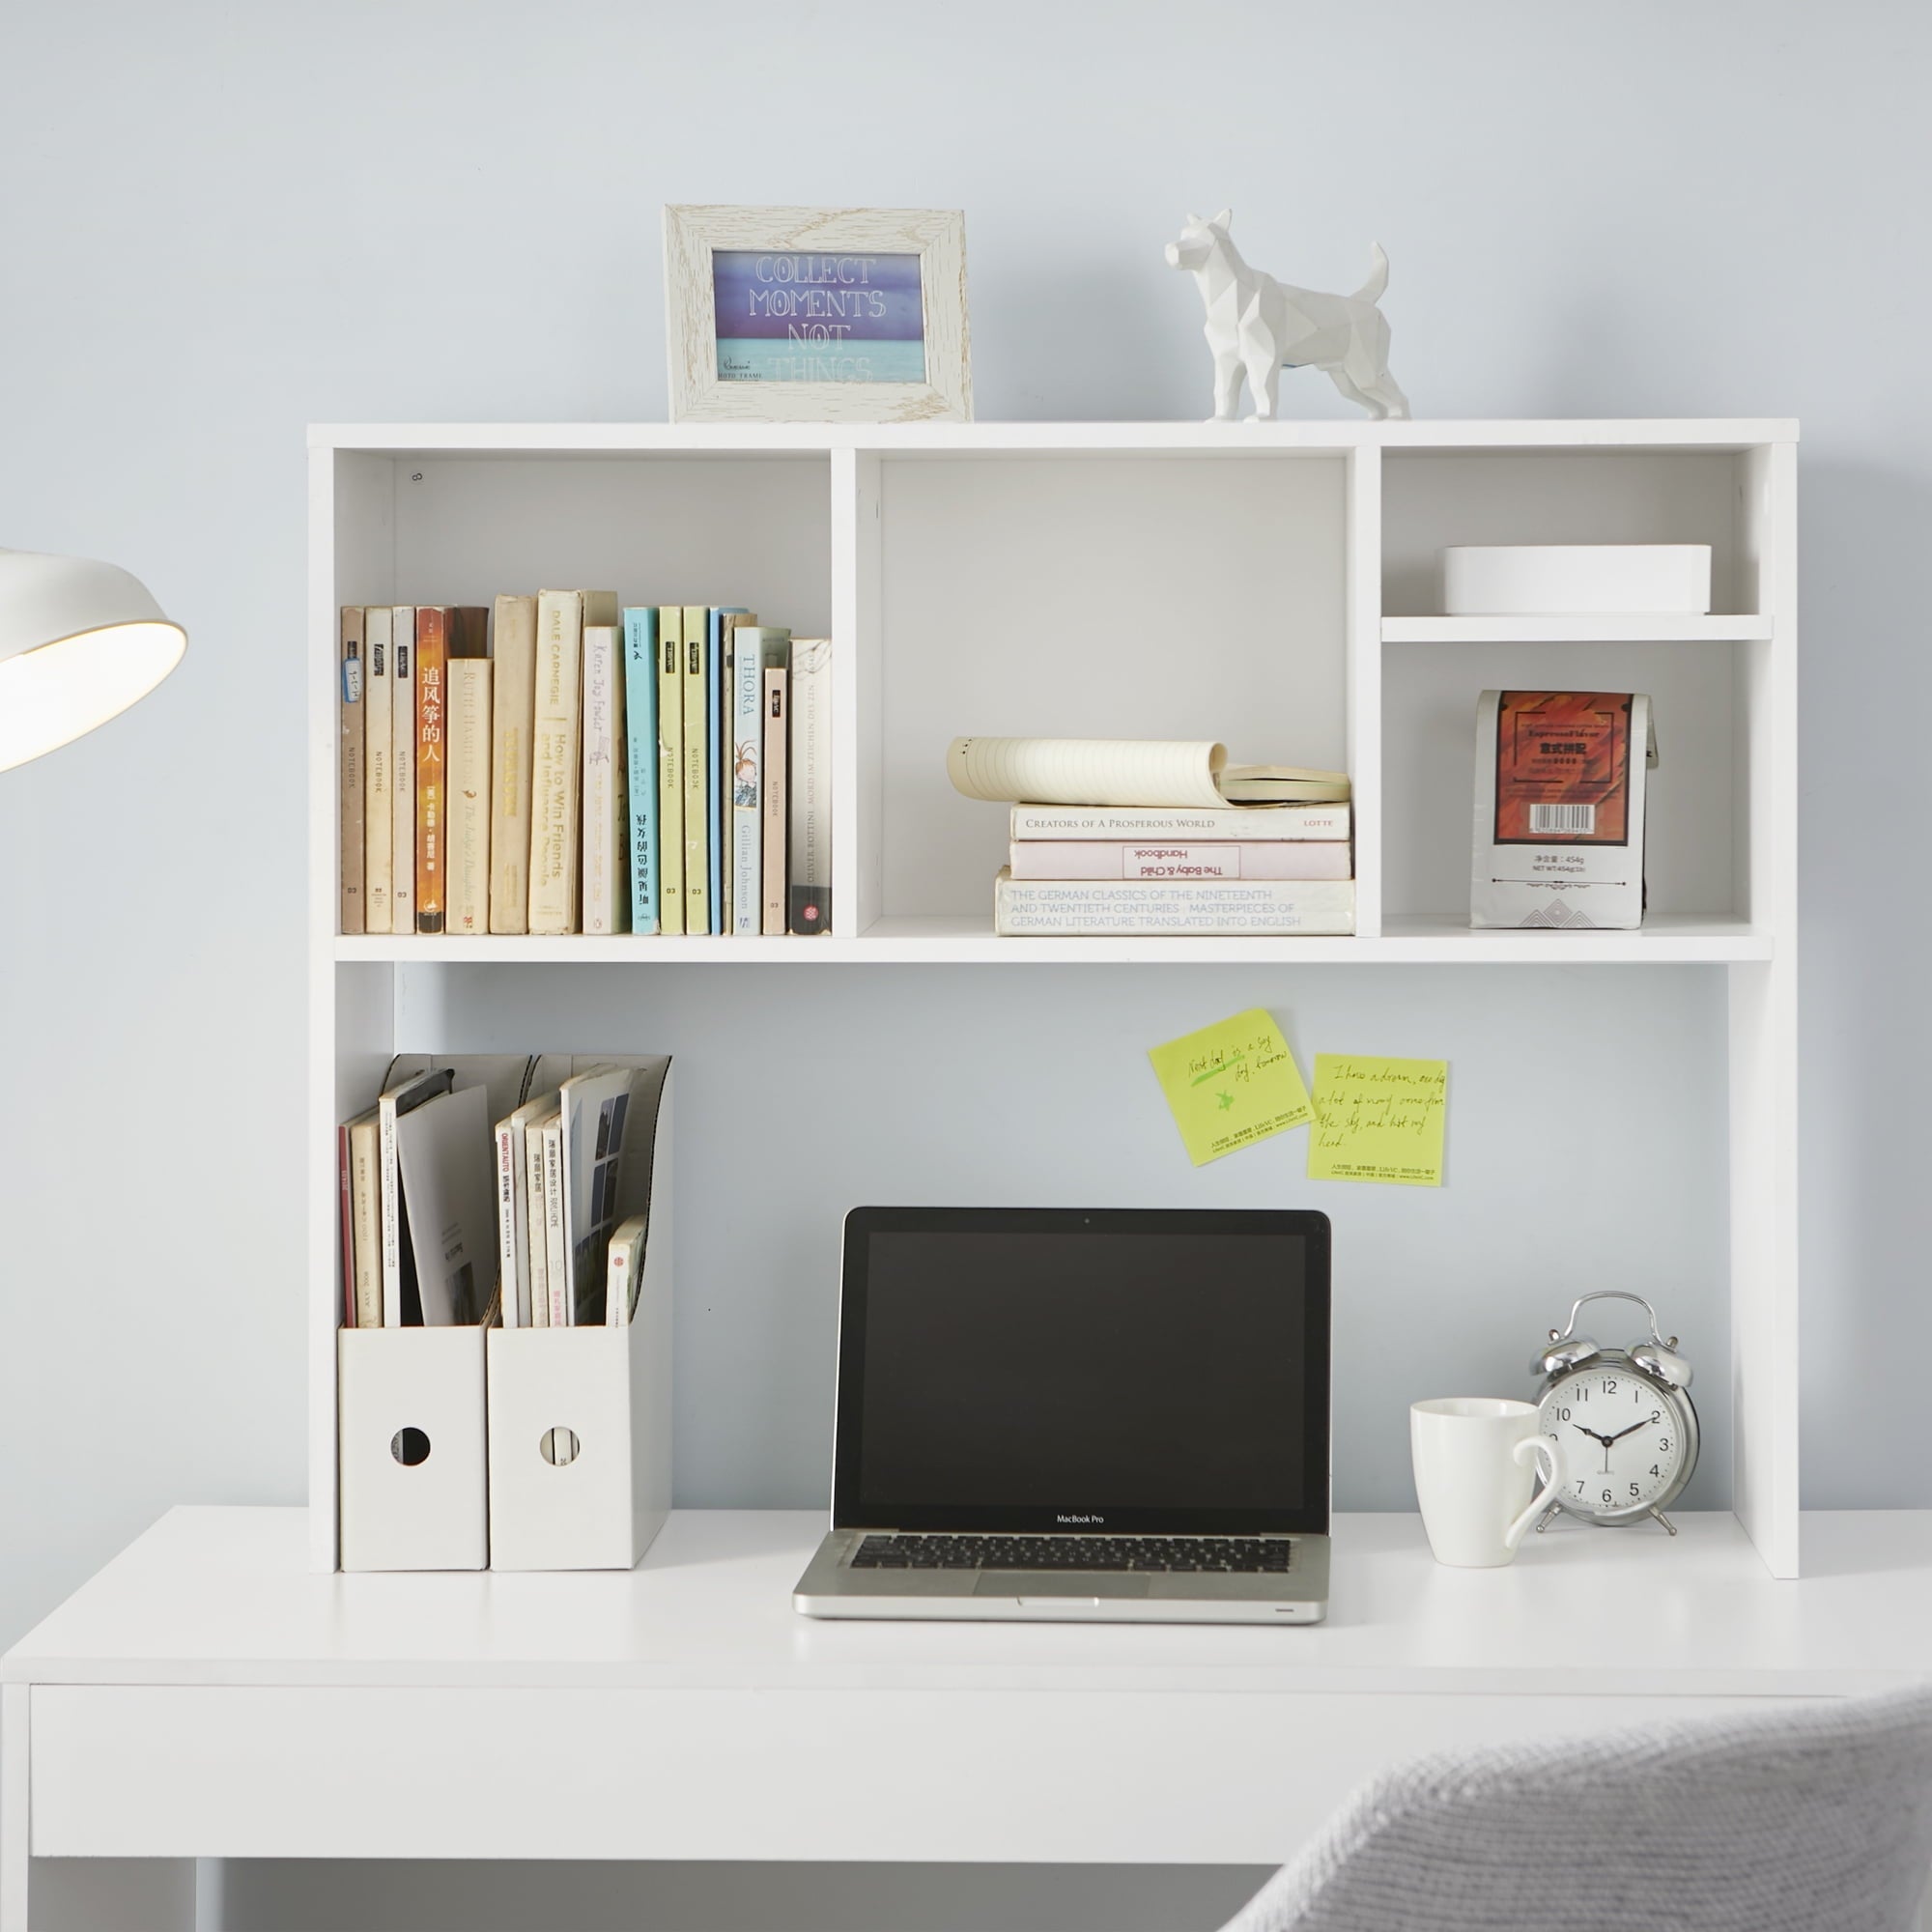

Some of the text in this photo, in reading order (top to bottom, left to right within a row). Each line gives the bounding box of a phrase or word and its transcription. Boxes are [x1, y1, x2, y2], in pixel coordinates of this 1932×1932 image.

[755, 256, 875, 284] COLLECT
[749, 289, 887, 318] MOMENTS
[788, 324, 851, 351] NOT
[767, 356, 873, 382] THINGS
[550, 611, 561, 705] DALE CARNEGIE
[743, 654, 755, 716] THORA
[421, 667, 440, 762] 追风筝的人
[1540, 742, 1586, 754] 意式拼配
[552, 734, 566, 878] How to Win Friends
[1026, 818, 1215, 829] CREATORS OF A PROSPEROUS WORLD
[1304, 819, 1334, 828] LOTTE
[741, 825, 750, 863] Gillian
[636, 813, 649, 905] 听见颜色的女孩
[1134, 849, 1188, 859] Handbook
[1140, 866, 1223, 877] The Baby & Child
[740, 865, 752, 909] Johnson
[1011, 890, 1272, 900] THE GERMAN CLASSICS OF THE NINETEENTH
[1011, 903, 1037, 914] AND
[1039, 903, 1112, 914] TWENTIETH
[1189, 903, 1275, 914] MASTERPIECES
[1277, 903, 1294, 914] OF
[1011, 916, 1301, 927] GERMAN LITERATURE TRANSLATED INTO ENGLISH
[1577, 1387, 1589, 1402] 11
[1602, 1380, 1617, 1395] 12
[1556, 1407, 1571, 1422] 10
[1651, 1410, 1661, 1424] 2
[1659, 1437, 1669, 1452] 3
[1649, 1463, 1660, 1478] 4
[1576, 1480, 1585, 1494] 7
[1630, 1482, 1639, 1496] 5
[1602, 1489, 1612, 1503] 6
[1057, 1514, 1104, 1523] MacBook Pro
